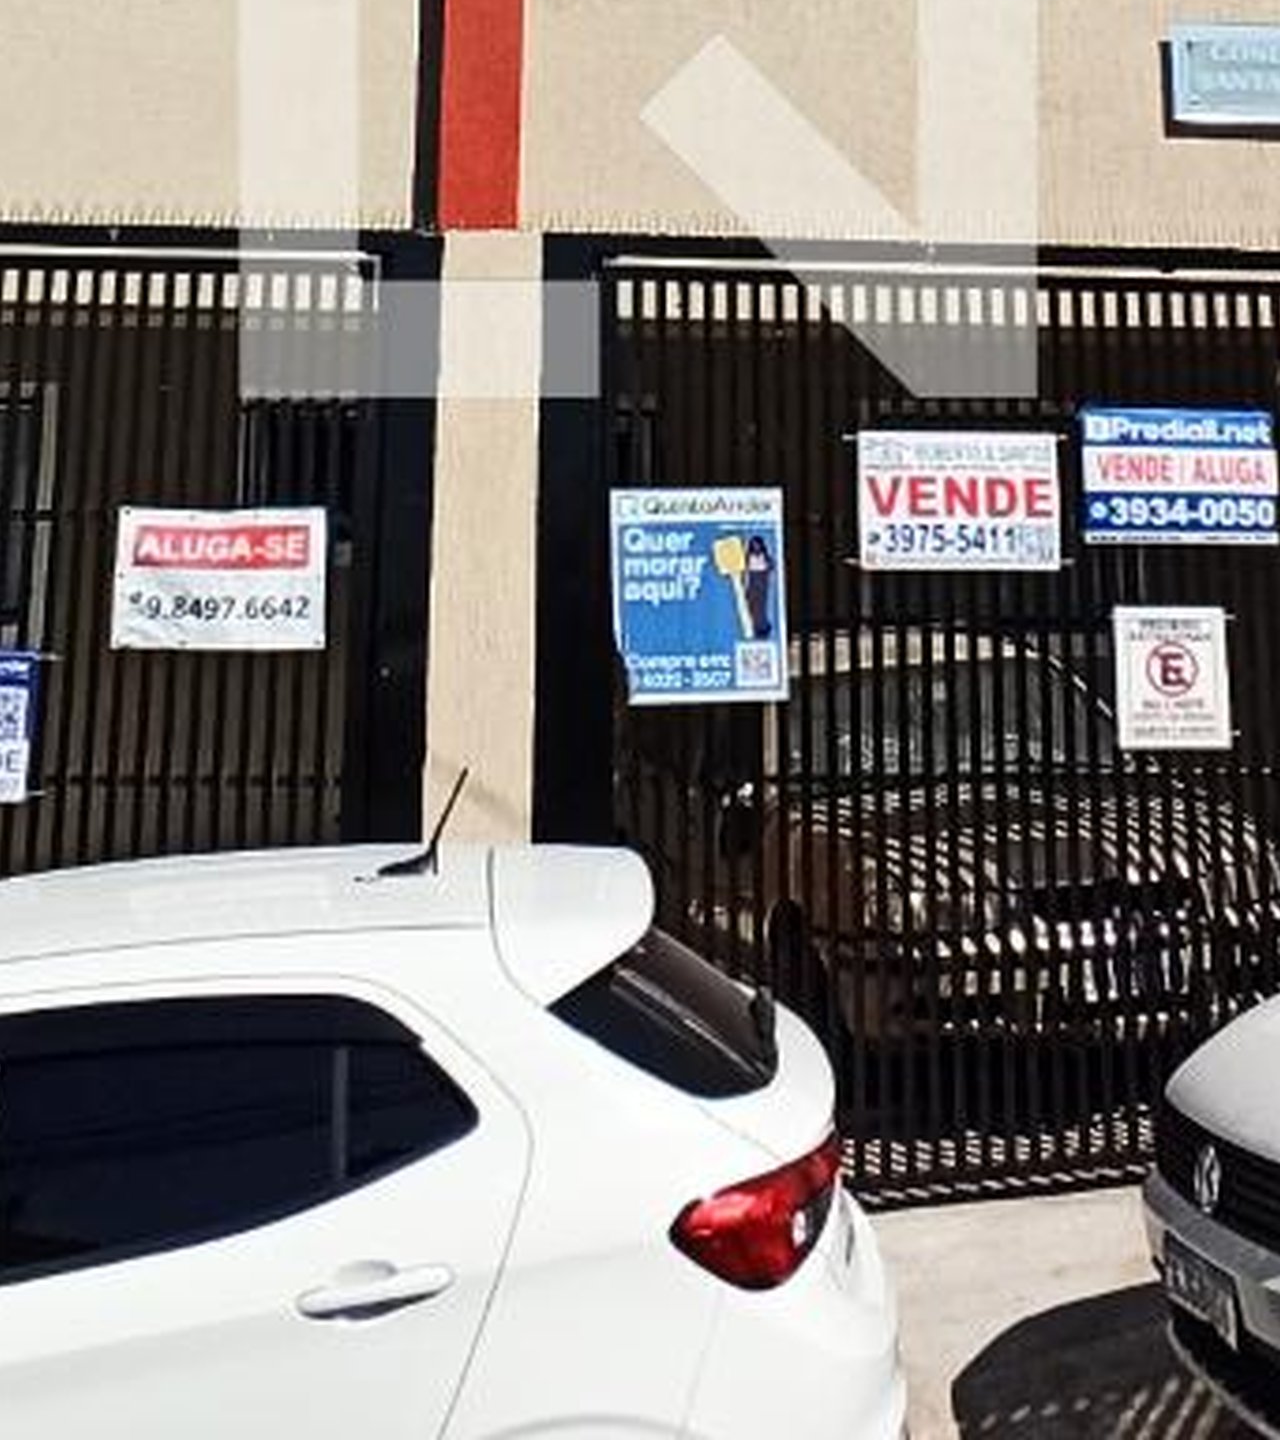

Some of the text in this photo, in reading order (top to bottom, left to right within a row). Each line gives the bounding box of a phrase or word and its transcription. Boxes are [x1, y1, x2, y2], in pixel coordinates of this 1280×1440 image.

[1097, 455, 1268, 484] VENDE ALUGA
[866, 475, 1054, 518] VENDE
[1110, 497, 1276, 527] 3934-0050
[137, 530, 307, 564] ALUGA-SE
[624, 528, 694, 553] Quer
[885, 524, 1017, 553] 3975-5411
[624, 557, 708, 577] morar
[624, 578, 701, 607] aqui?
